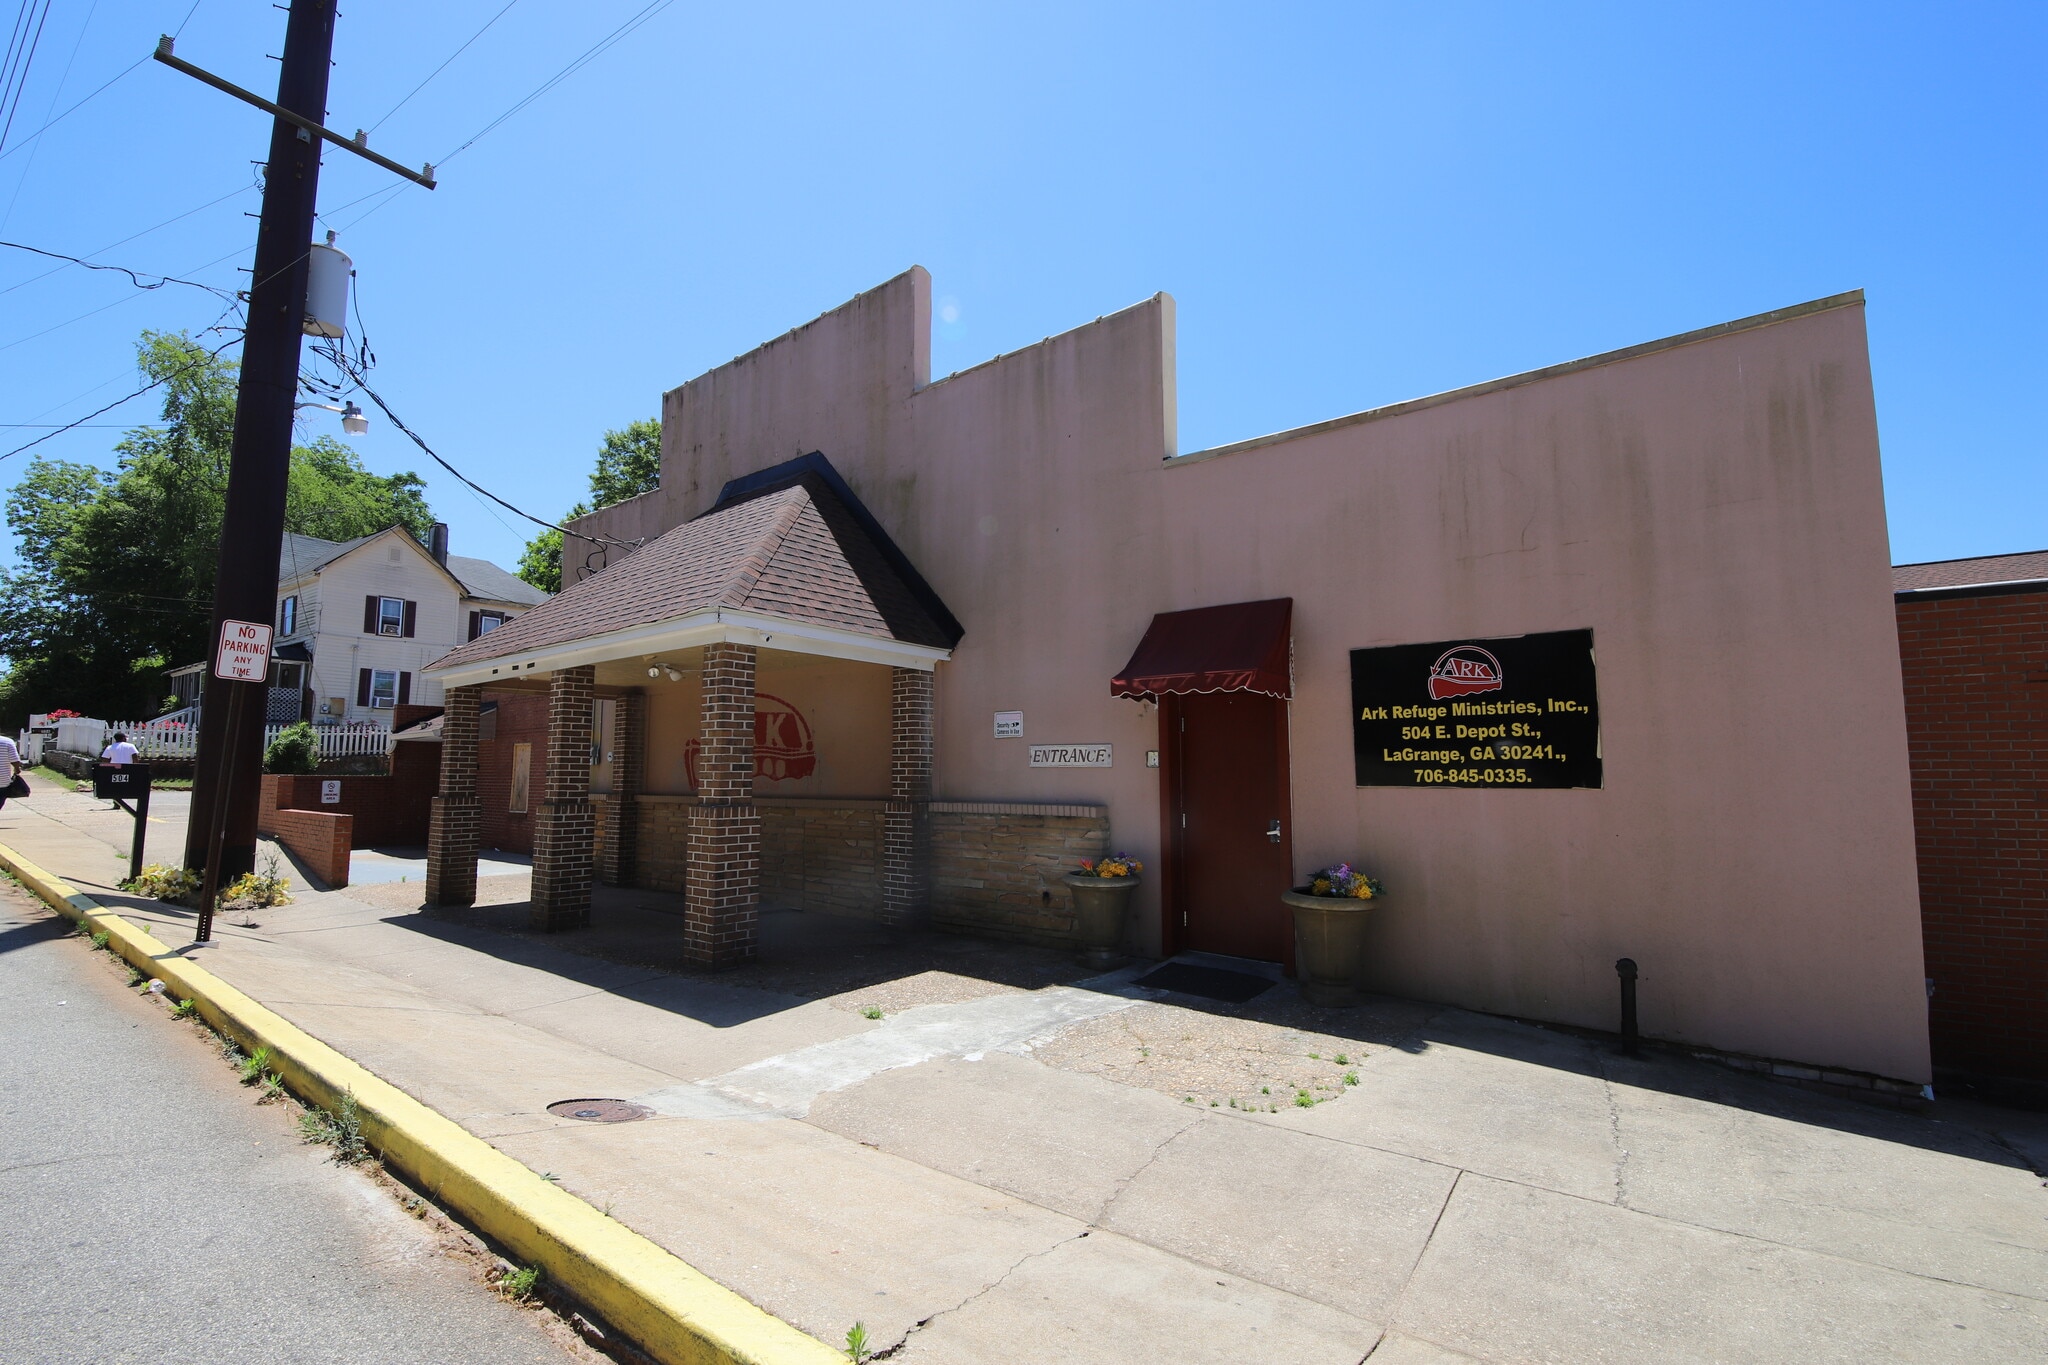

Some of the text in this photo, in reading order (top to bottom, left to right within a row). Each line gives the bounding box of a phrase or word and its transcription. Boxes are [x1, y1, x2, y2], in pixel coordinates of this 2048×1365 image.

[238, 627, 256, 639] NO
[224, 640, 265, 655] PARKING
[234, 656, 252, 664] ANY
[1440, 658, 1487, 677] ARK
[232, 667, 251, 676] TIME
[1361, 698, 1589, 722] Ark Refuge Ministries, Inc.,
[1401, 722, 1542, 741] 504 E. Depot St.,
[1033, 749, 1106, 762] ENTRANCE
[1383, 744, 1567, 764] LaGrange, GA 30241.,
[111, 774, 129, 783] 504
[1414, 768, 1532, 784] 706-845-0335.
